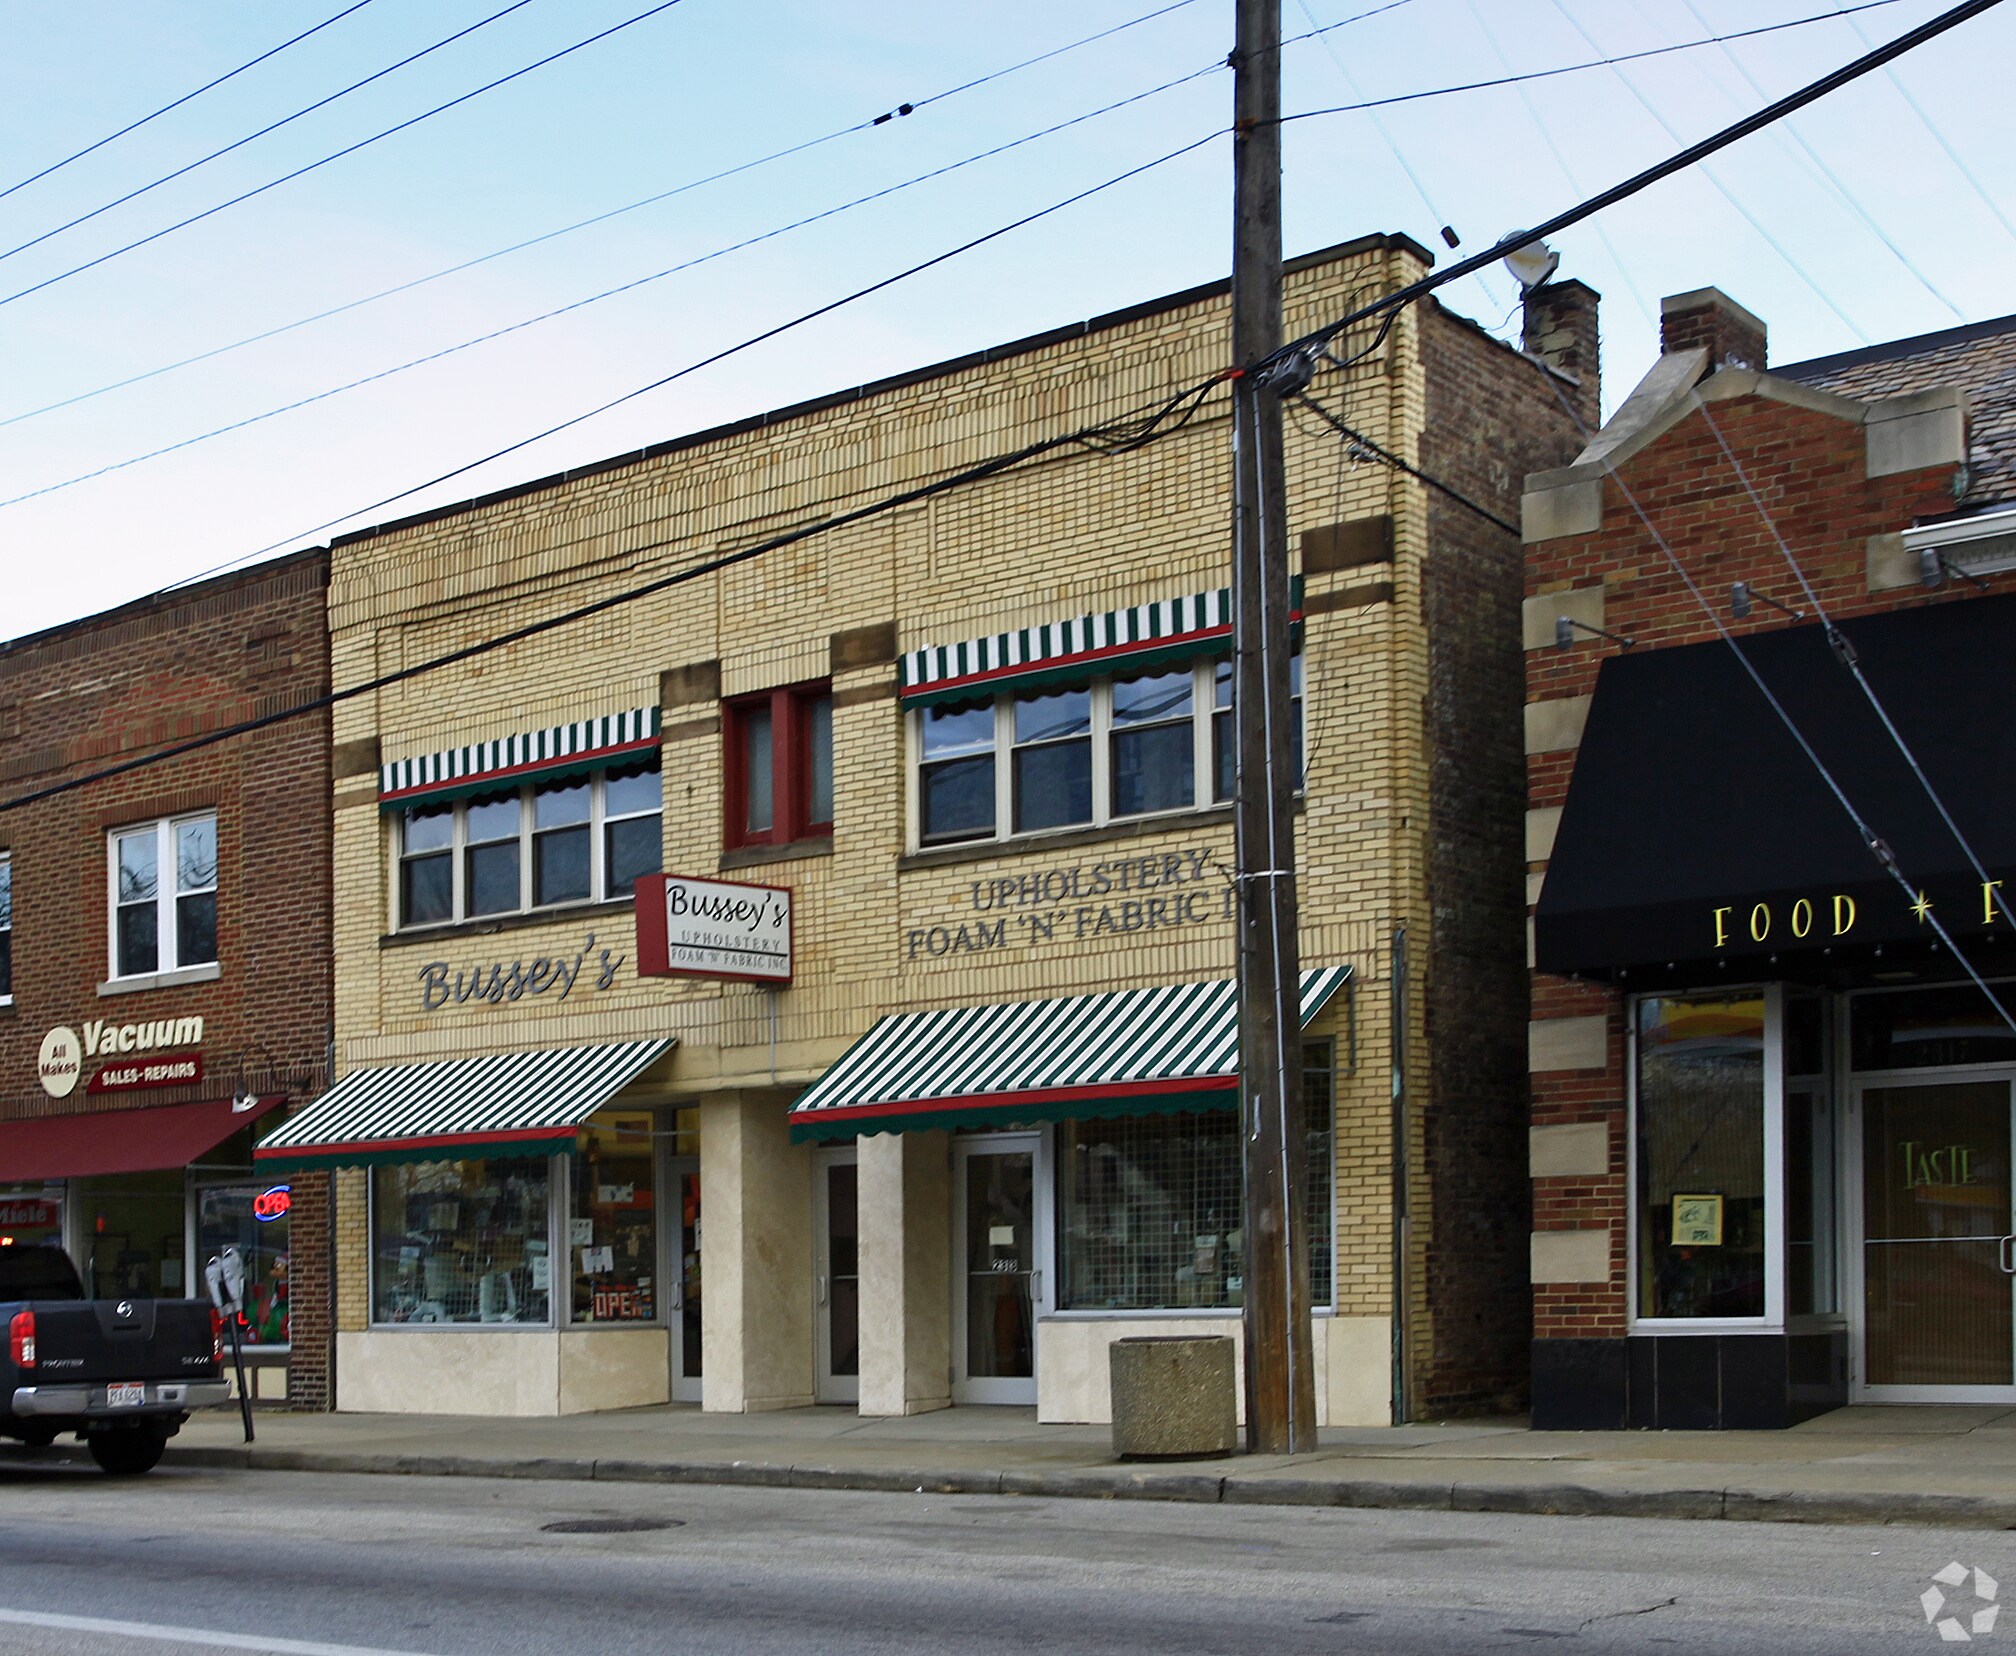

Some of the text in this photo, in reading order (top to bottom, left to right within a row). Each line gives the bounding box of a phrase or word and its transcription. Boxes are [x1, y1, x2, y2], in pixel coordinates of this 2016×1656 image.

[969, 848, 1213, 912] UPHOLSTERY
[667, 884, 788, 932] Bussey's
[906, 916, 1008, 960] FOAM
[1016, 909, 1066, 945] 'N'
[1074, 889, 1211, 939] FABRIC
[1713, 894, 1856, 949] FOOD
[671, 947, 704, 963] FOAM
[724, 952, 765, 969] FABRIC
[681, 929, 781, 952] UPHOLSTERY
[417, 933, 628, 1011] Bussey's
[52, 1043, 67, 1060] All
[82, 1015, 204, 1057] Vacuum
[41, 1061, 78, 1077] Makes
[254, 1190, 291, 1215] OPEN
